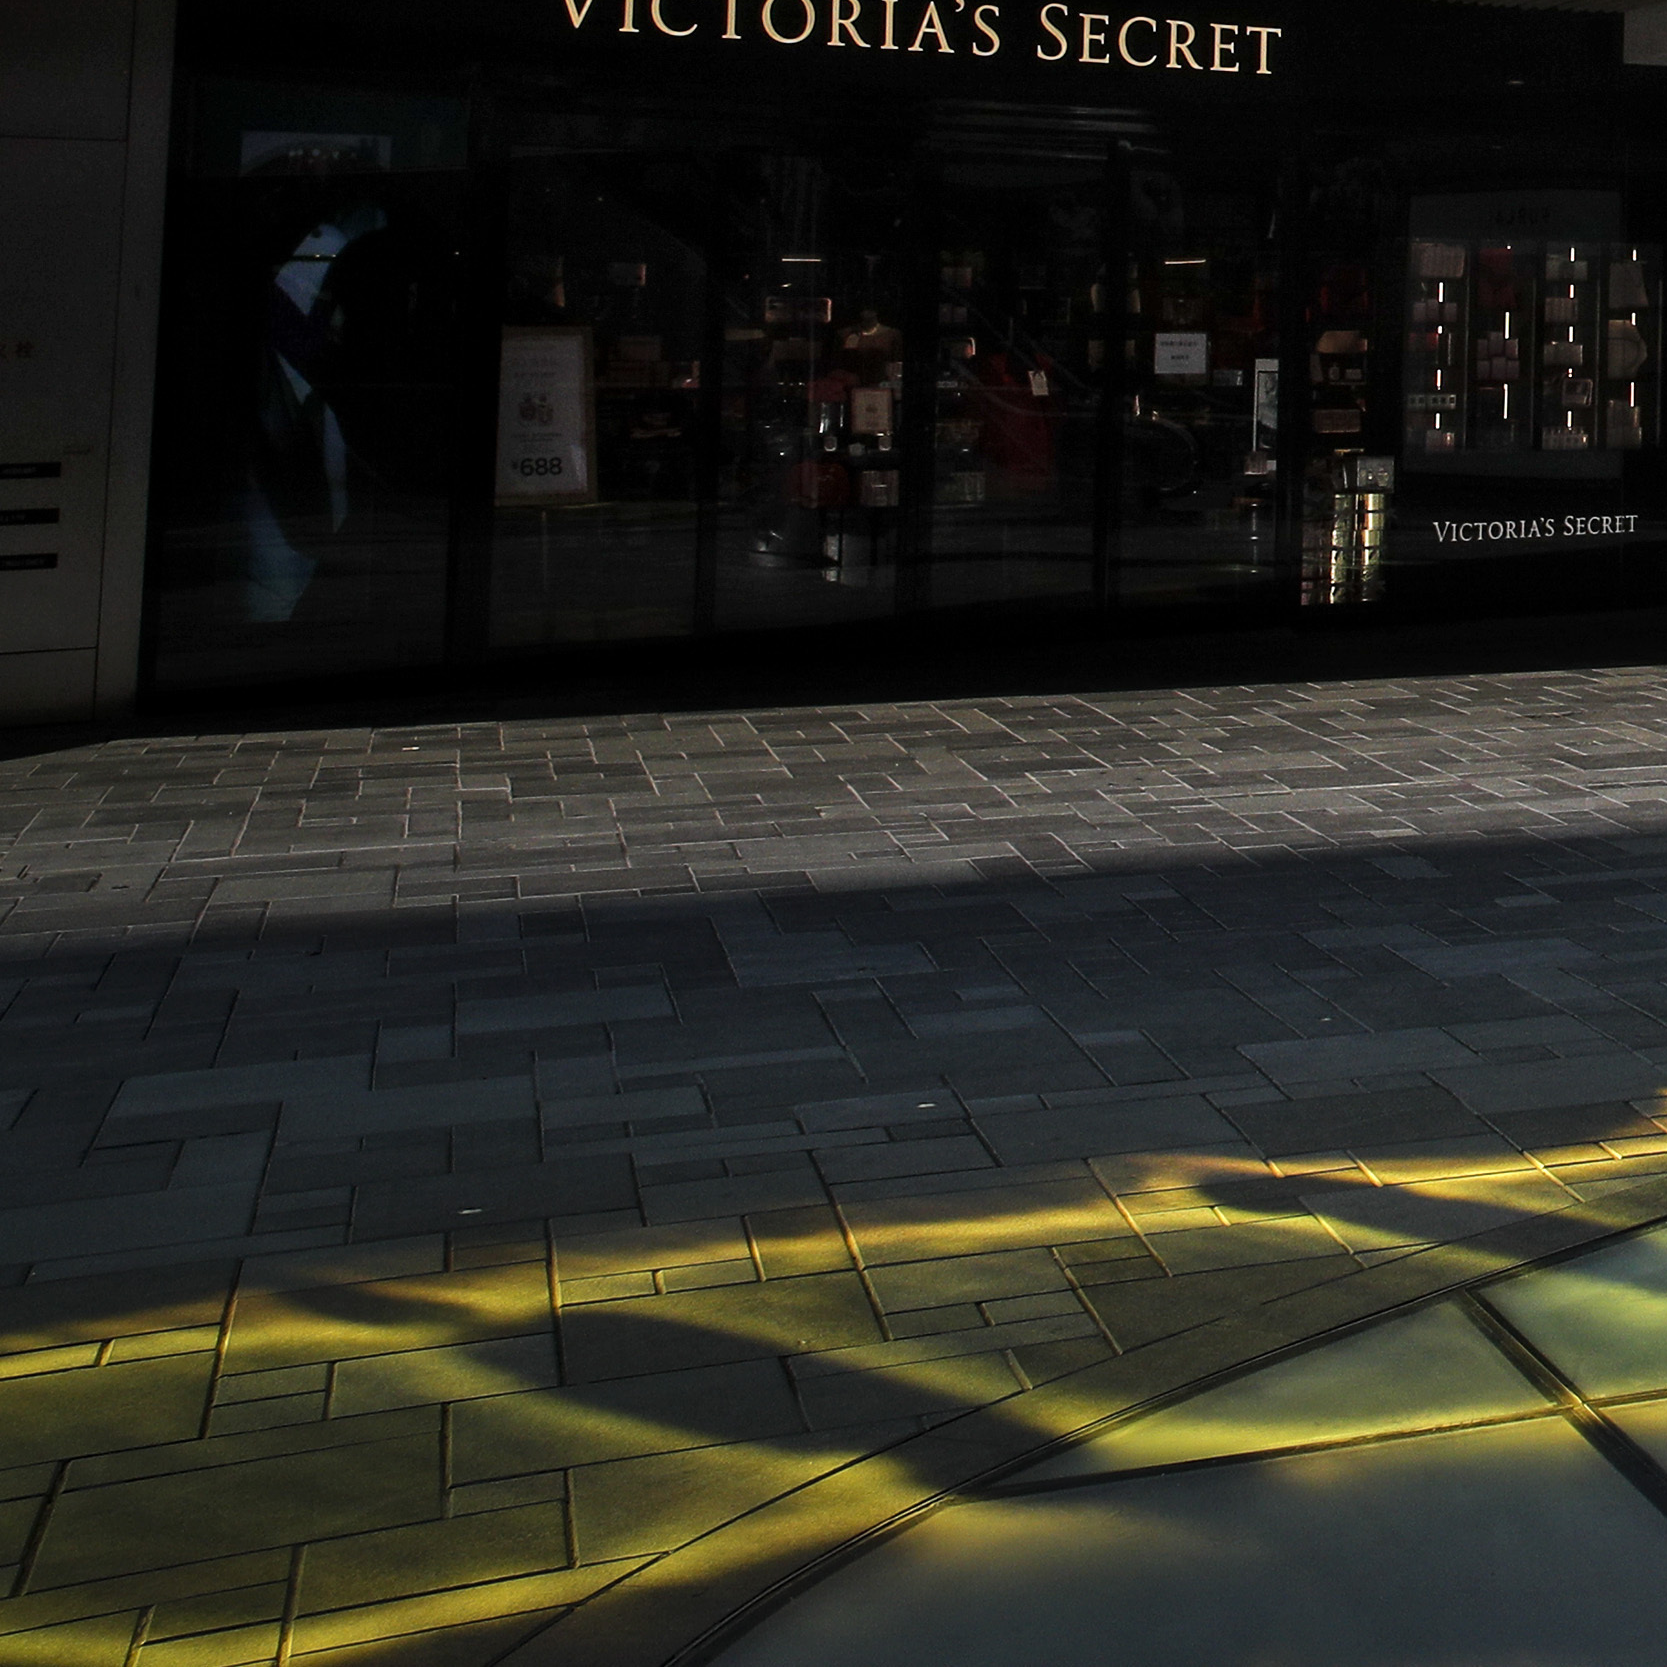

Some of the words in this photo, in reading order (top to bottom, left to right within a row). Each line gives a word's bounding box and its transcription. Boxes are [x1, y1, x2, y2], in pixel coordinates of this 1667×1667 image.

[1036, 3, 1282, 75] SECRET
[1432, 515, 1555, 544] VICTORIA'S
[1564, 513, 1639, 537] SECRET
